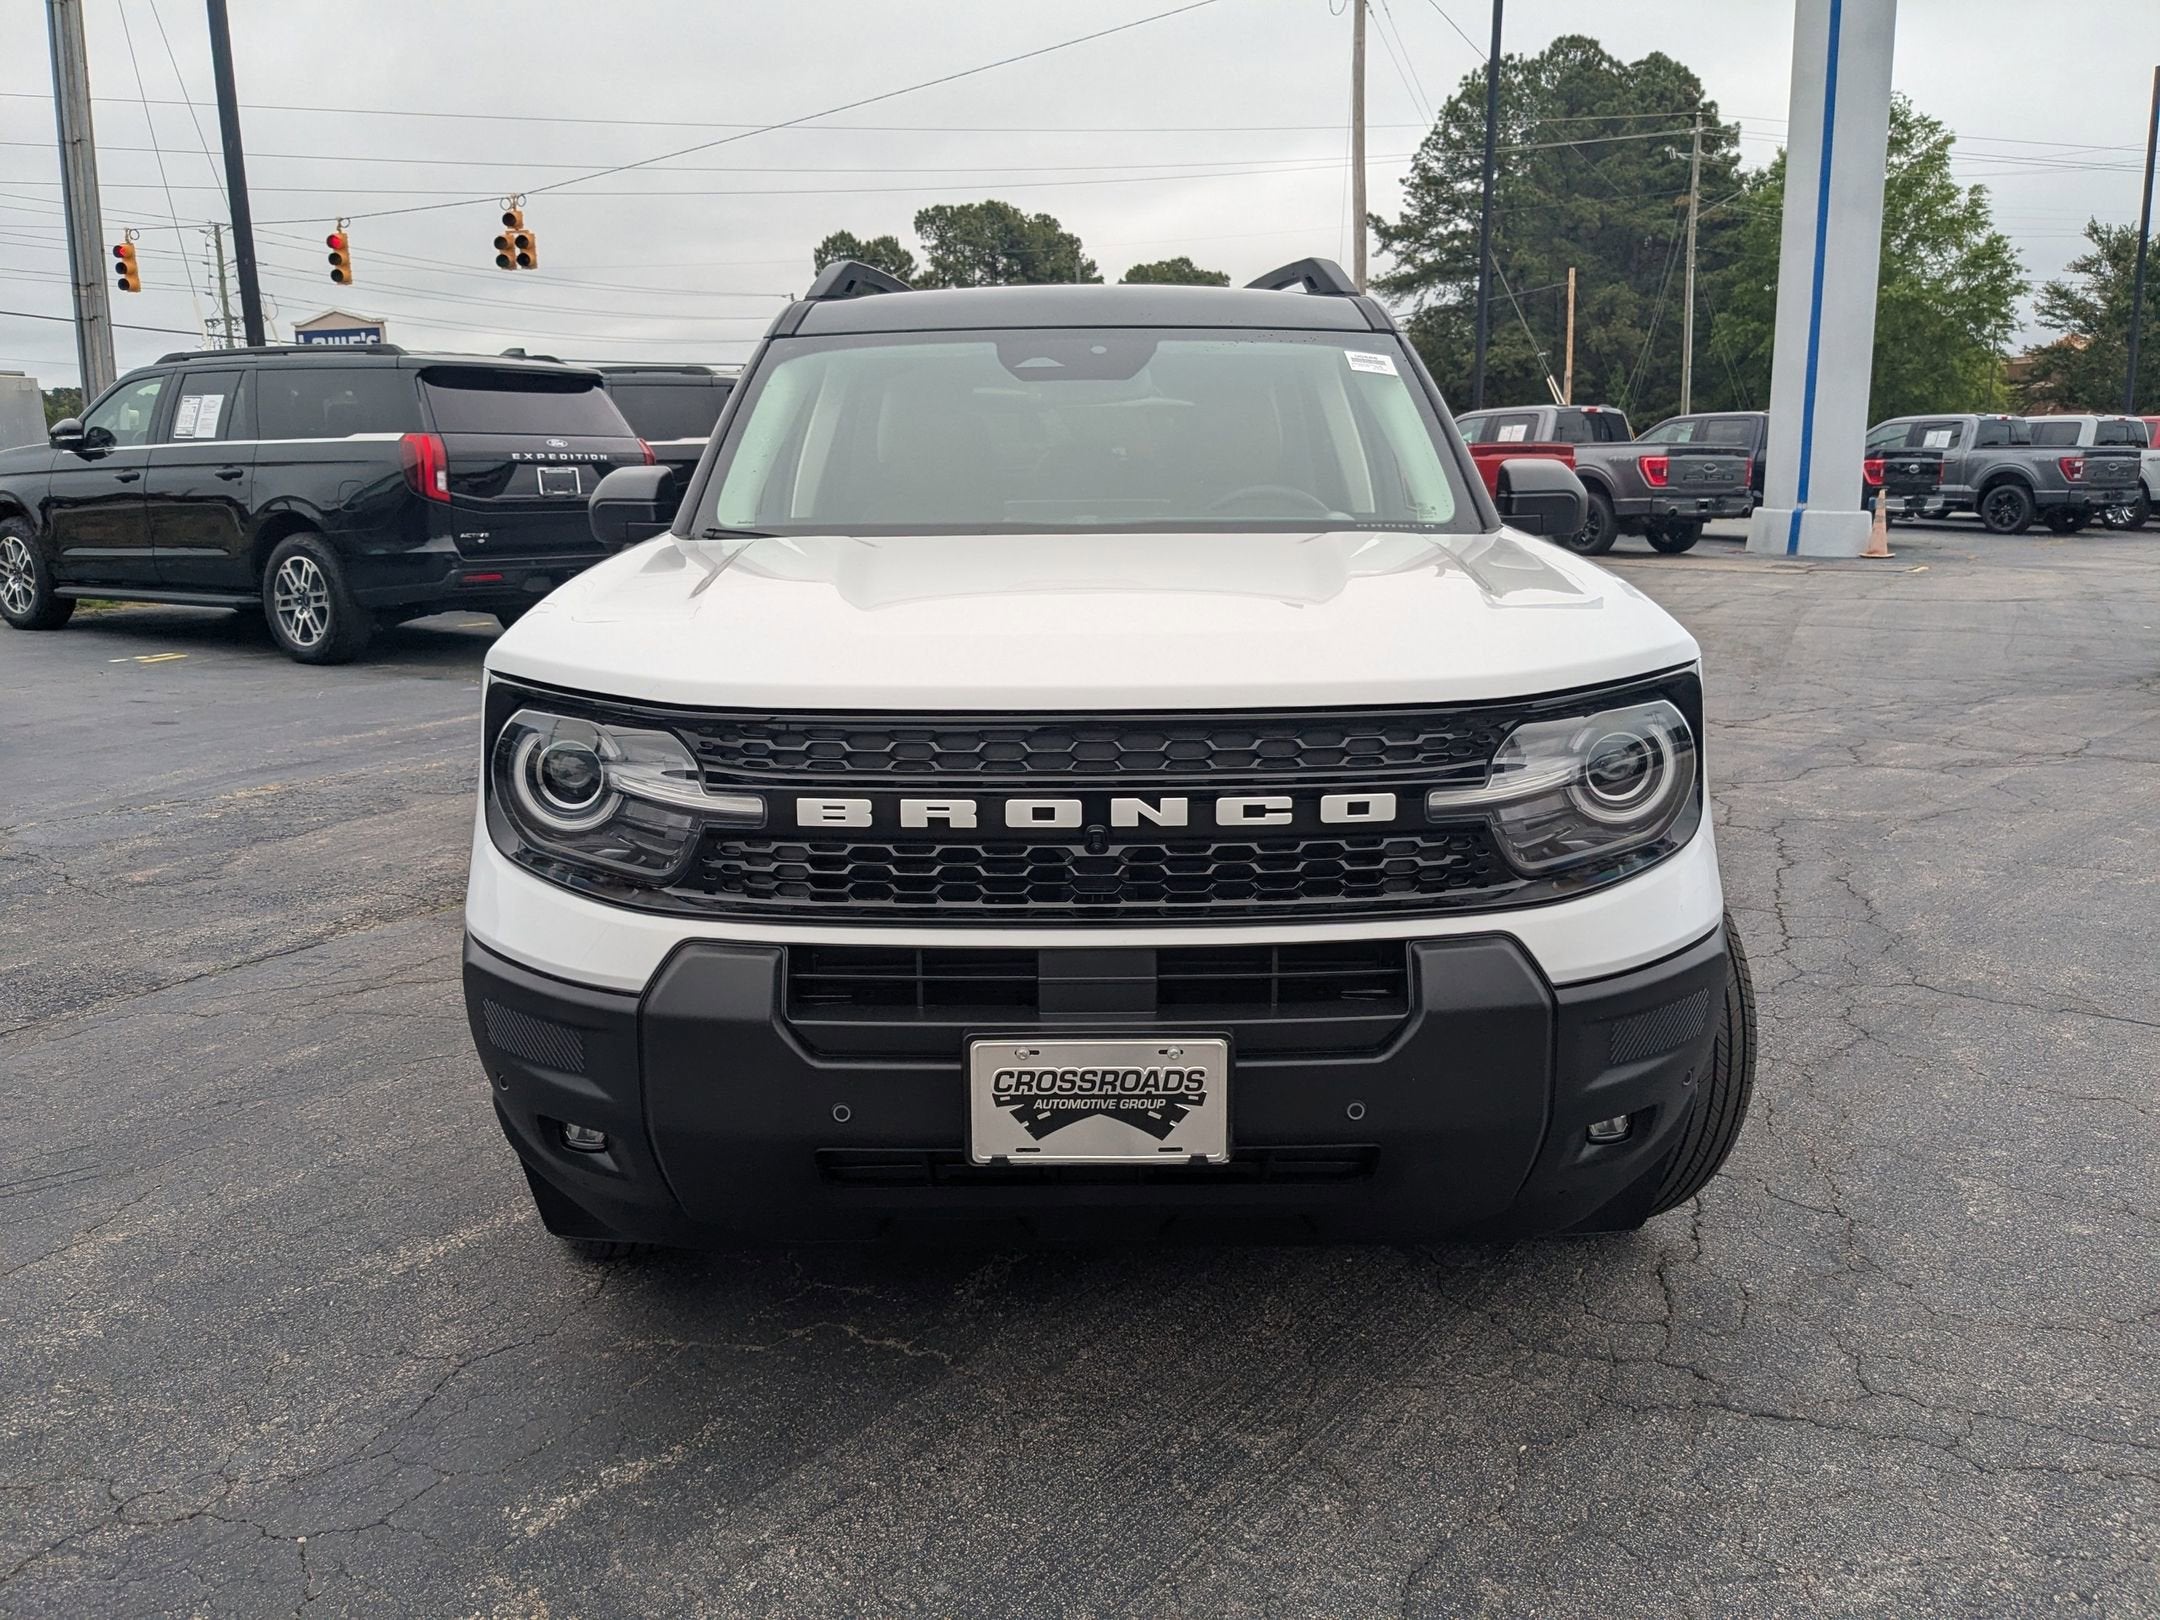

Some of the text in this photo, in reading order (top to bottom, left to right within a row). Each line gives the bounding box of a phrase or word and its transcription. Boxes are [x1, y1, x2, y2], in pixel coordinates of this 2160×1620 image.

[511, 453, 608, 461] EXPEDITION
[796, 792, 1397, 829] BRONCO
[993, 1070, 1206, 1094] CROSSROADS
[1033, 1098, 1167, 1110] AUTOMOTIVE GROUP
